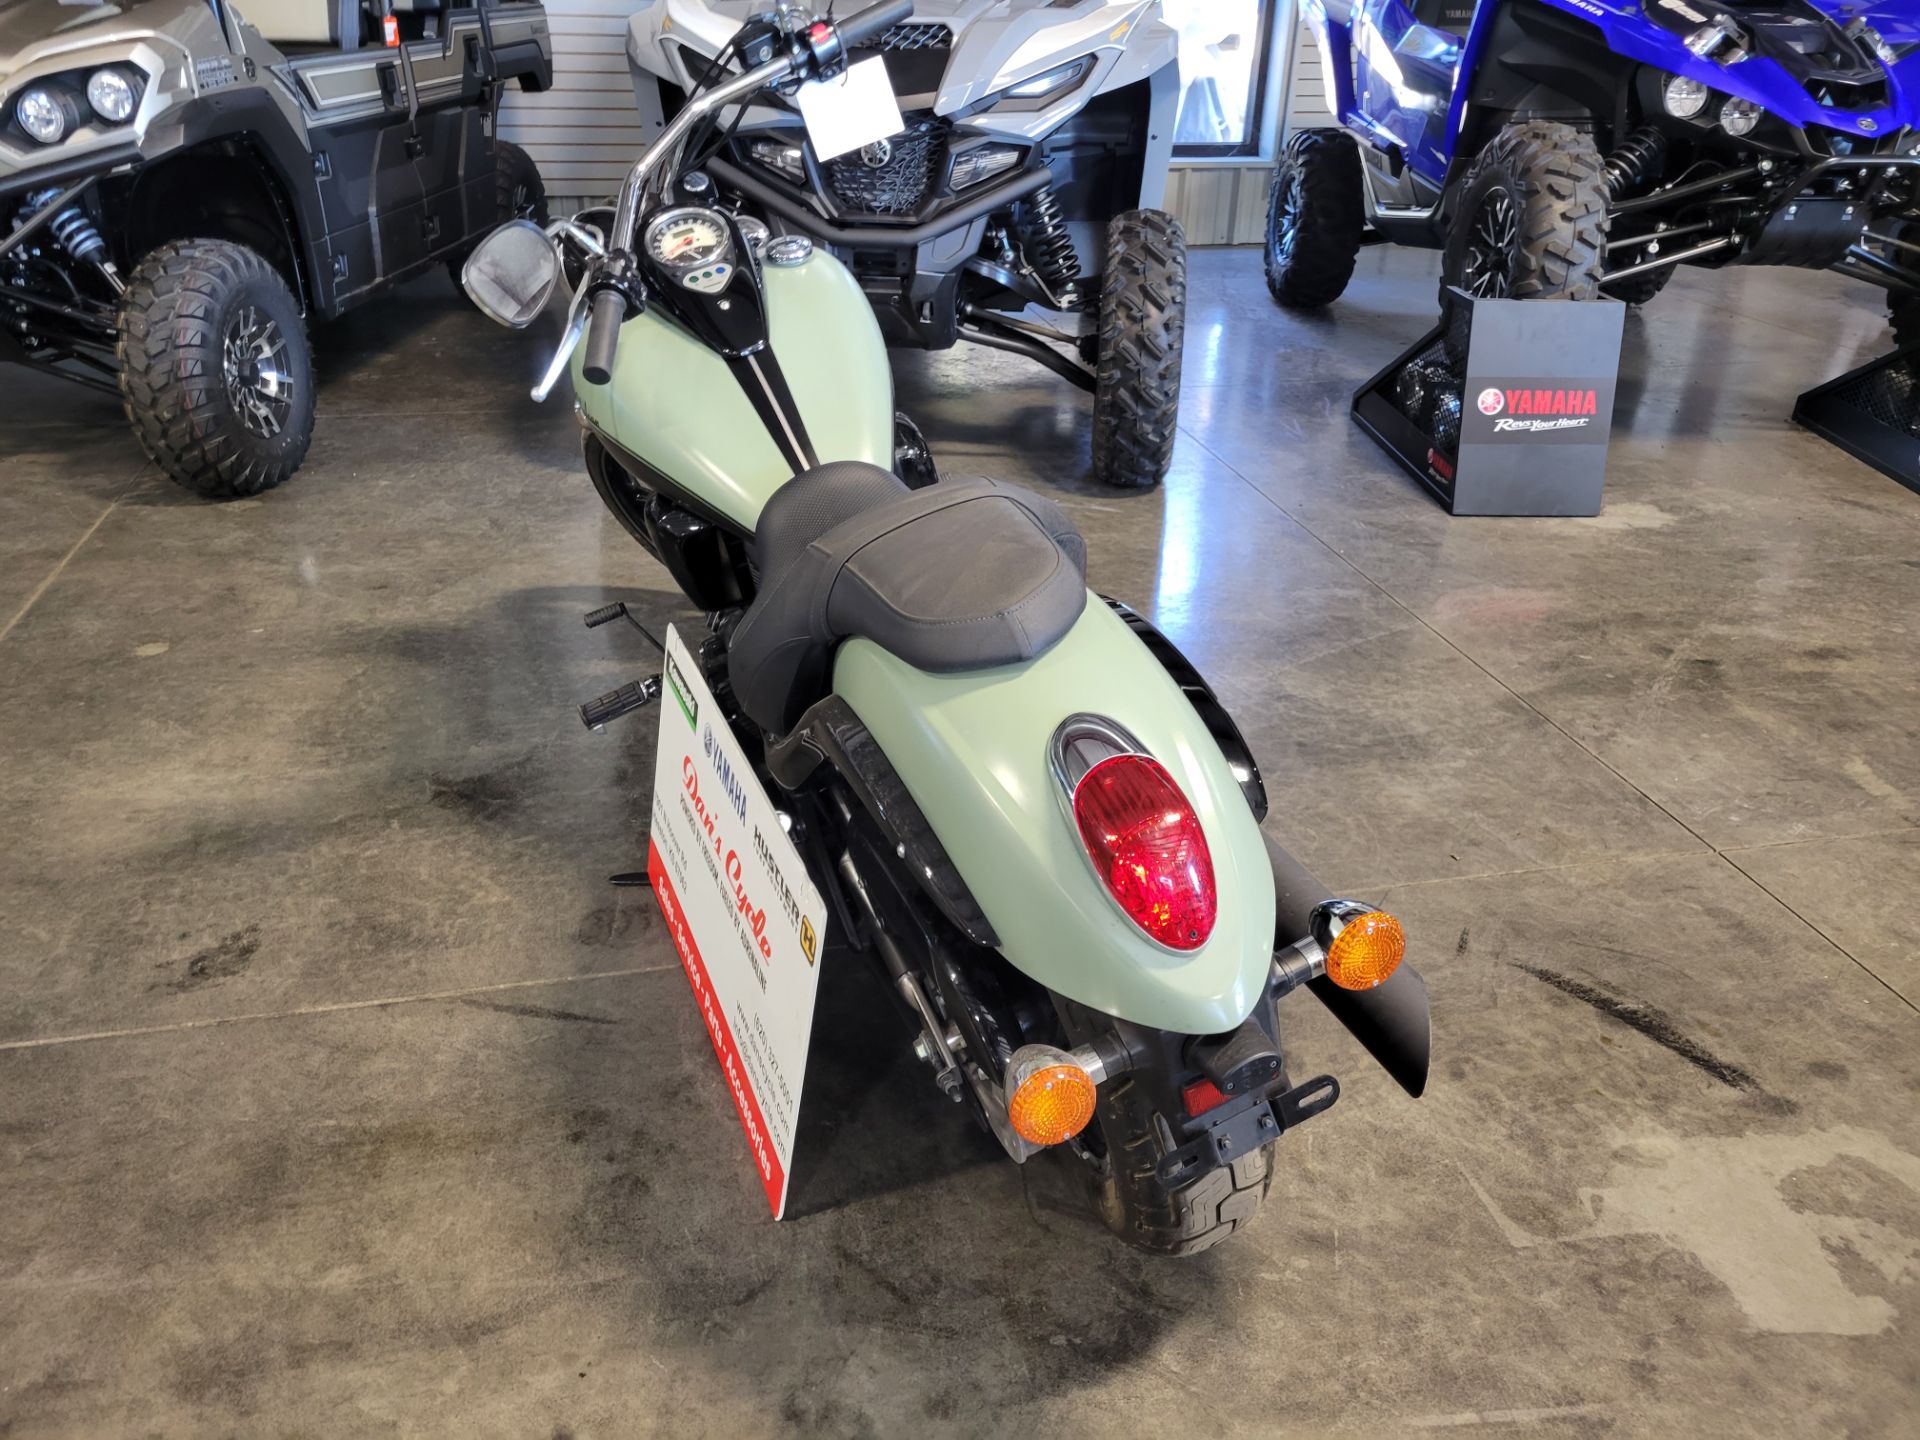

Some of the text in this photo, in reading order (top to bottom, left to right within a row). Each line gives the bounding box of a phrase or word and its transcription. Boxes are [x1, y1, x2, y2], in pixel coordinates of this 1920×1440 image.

[1493, 418, 1589, 432] Revs Your Heart
[1505, 389, 1597, 416] YAMAHA
[711, 739, 747, 826] YAMAHA
[682, 754, 771, 964] Dan's Cycle
[754, 825, 800, 925] HUSTLER
[741, 926, 767, 994] ADRENALINE
[659, 876, 674, 921] Sales
[677, 922, 701, 990] Service
[704, 993, 722, 1049] Parts
[726, 1050, 772, 1183] Accessories
